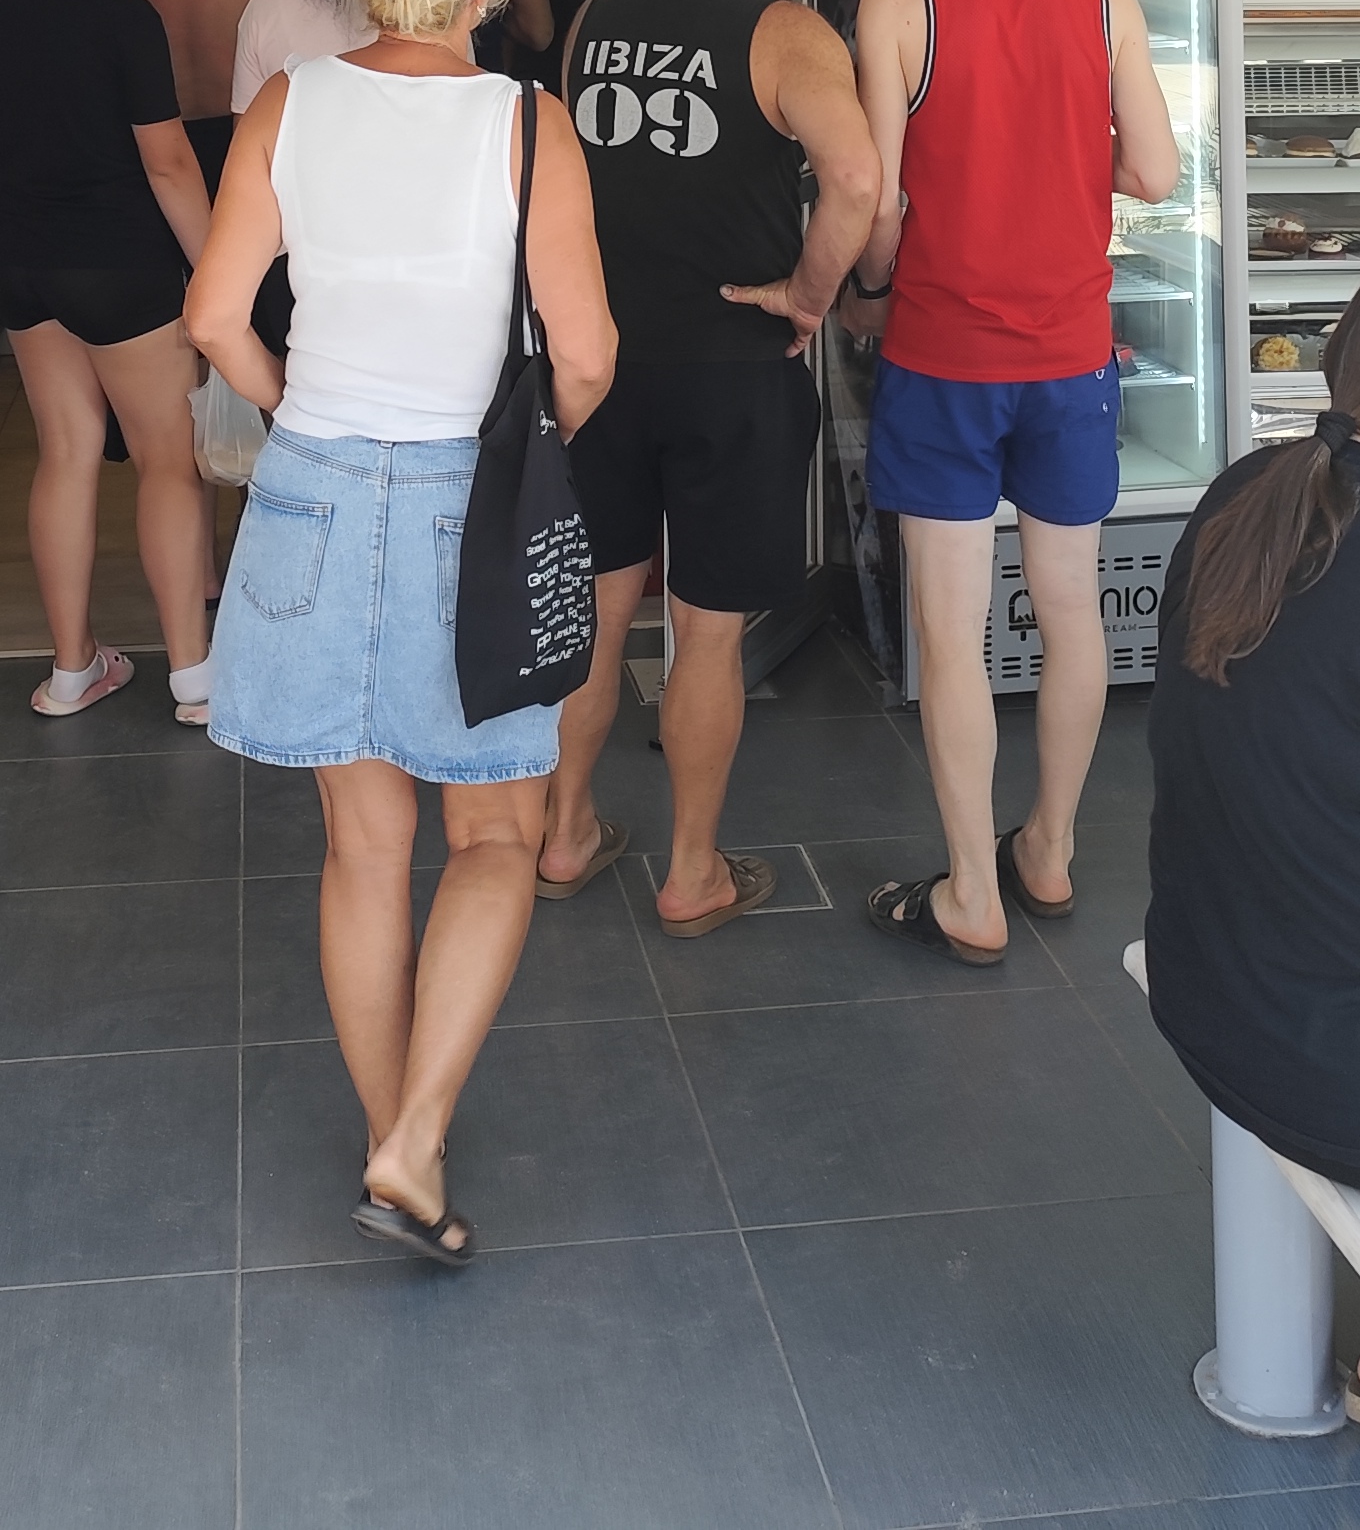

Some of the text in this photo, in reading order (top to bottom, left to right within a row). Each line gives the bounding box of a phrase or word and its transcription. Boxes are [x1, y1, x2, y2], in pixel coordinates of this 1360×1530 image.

[582, 40, 718, 89] IBIZA
[575, 82, 719, 158] 09
[1104, 623, 1137, 633] REAM
